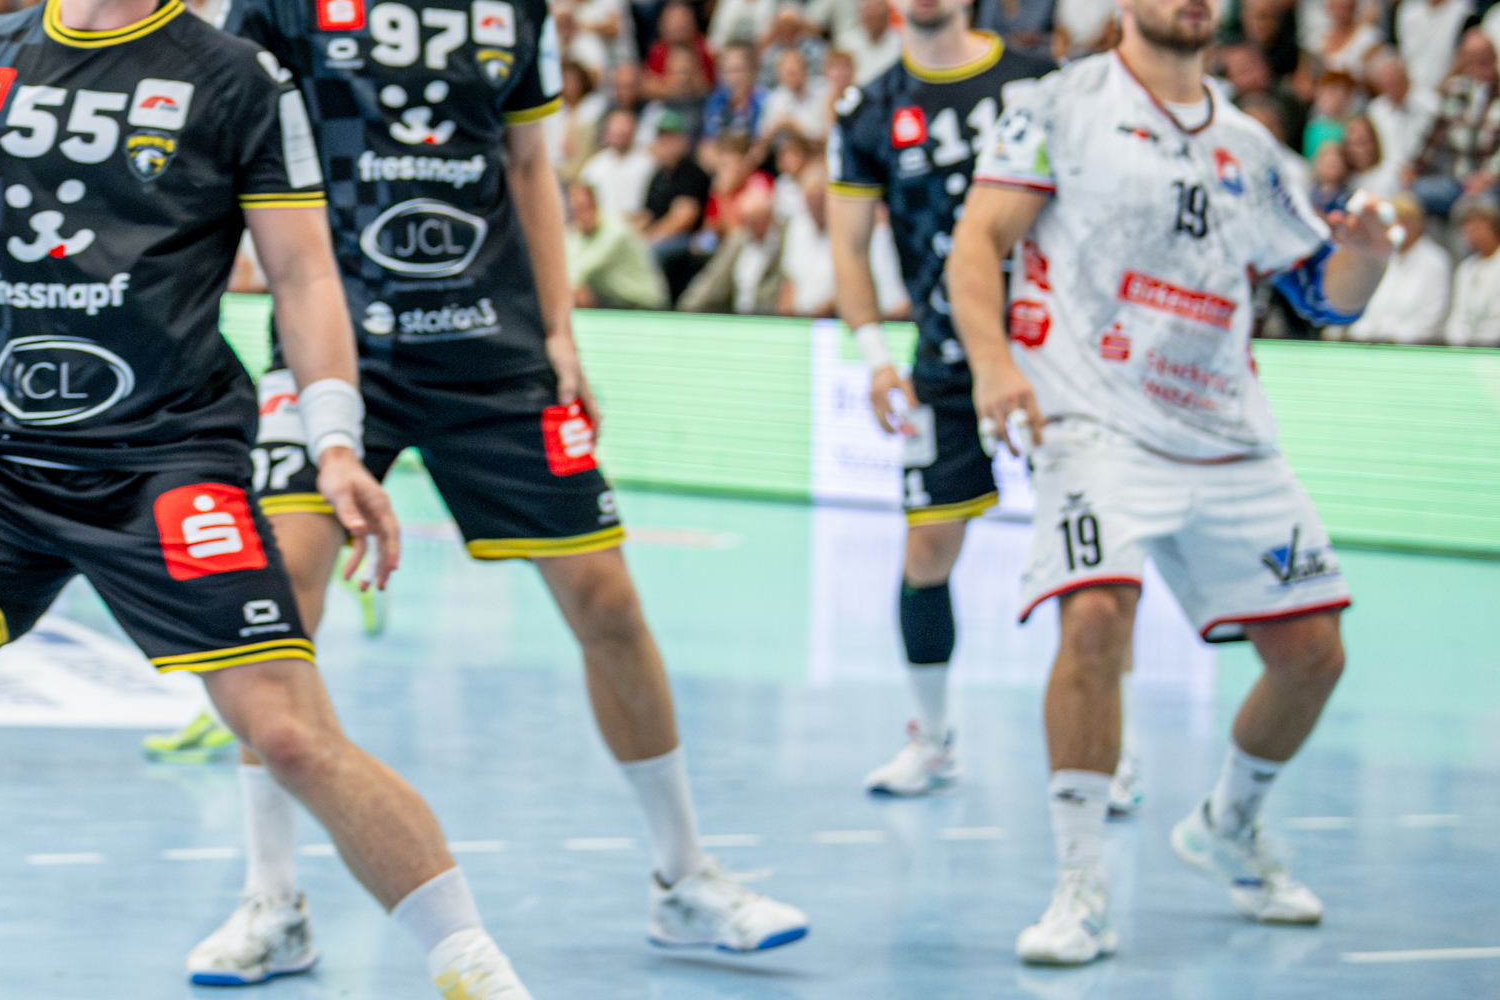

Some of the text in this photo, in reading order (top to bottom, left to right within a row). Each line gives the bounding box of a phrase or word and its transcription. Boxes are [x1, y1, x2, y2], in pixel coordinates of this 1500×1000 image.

[369, 2, 469, 71] 97
[0, 84, 130, 165] 55
[358, 150, 488, 190] fressnapf
[394, 217, 466, 258] JCL
[1171, 178, 1209, 239] 19
[1055, 513, 1102, 572] 19
